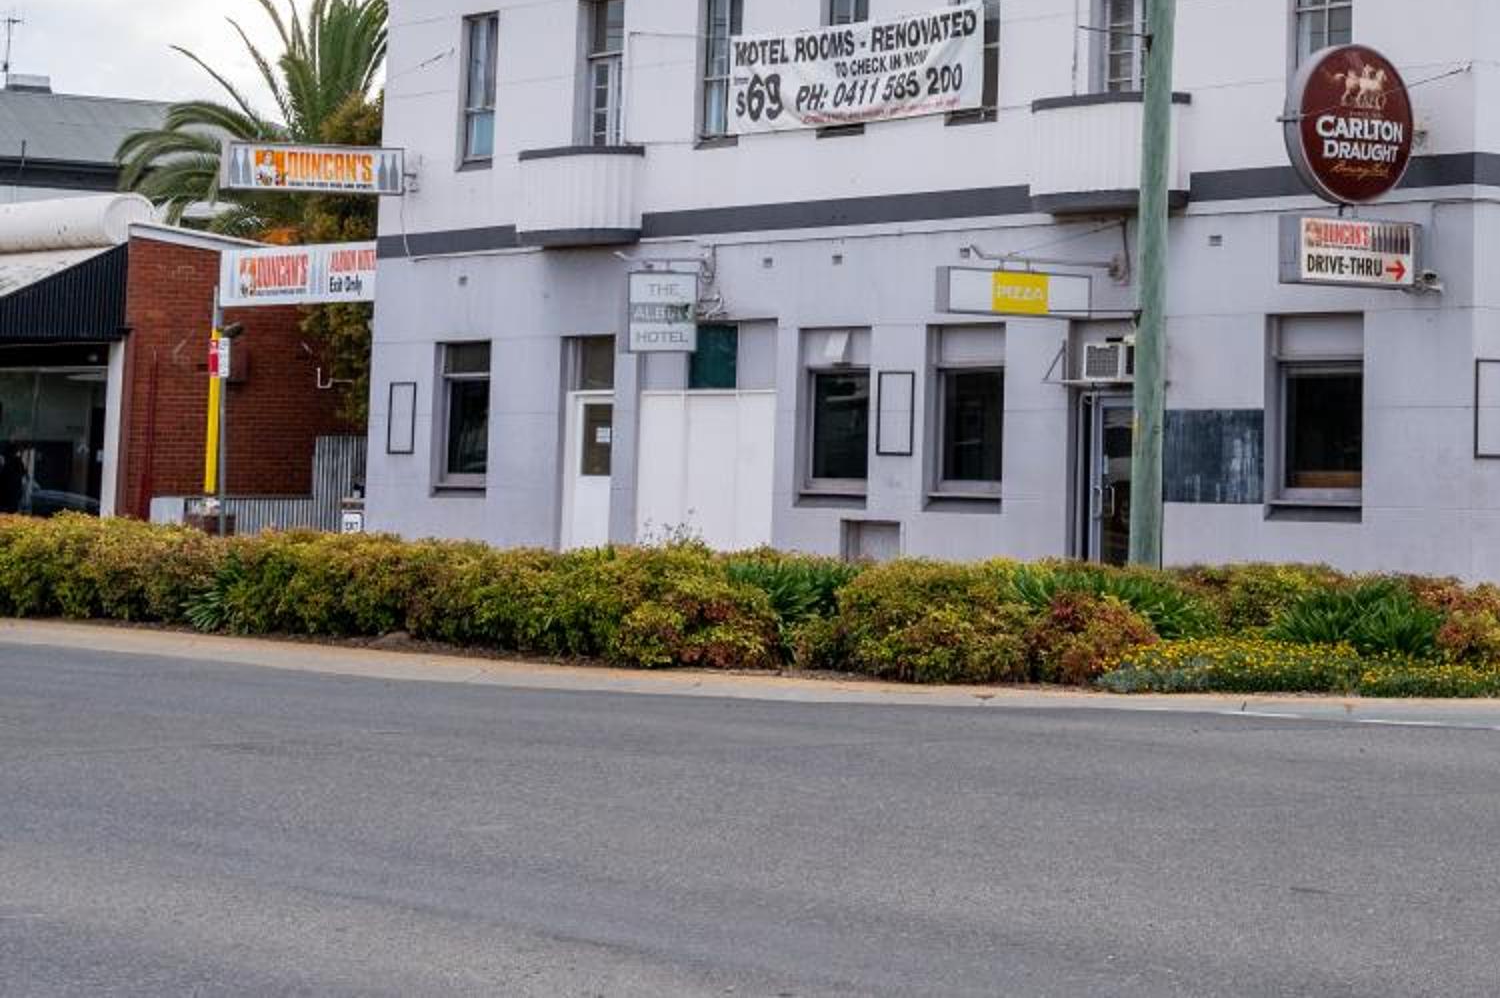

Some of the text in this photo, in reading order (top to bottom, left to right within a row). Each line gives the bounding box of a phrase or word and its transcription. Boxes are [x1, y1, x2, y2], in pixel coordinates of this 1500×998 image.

[735, 39, 789, 67] MOTEL
[794, 30, 855, 62] ROOMS
[871, 9, 977, 52] RENOVATED
[834, 61, 848, 78] TO
[850, 56, 887, 76] CHECK
[890, 53, 901, 71] IN
[796, 83, 828, 112] PH:
[833, 78, 880, 107] 0411
[926, 63, 963, 96] 200
[1315, 114, 1403, 142] CARLTON
[1323, 139, 1399, 163] DRAUGHT
[288, 151, 373, 183] DUNCAN'S
[1307, 253, 1383, 277] DRIVE-THRU
[647, 283, 681, 297] THE
[636, 331, 689, 343] HOTEL
